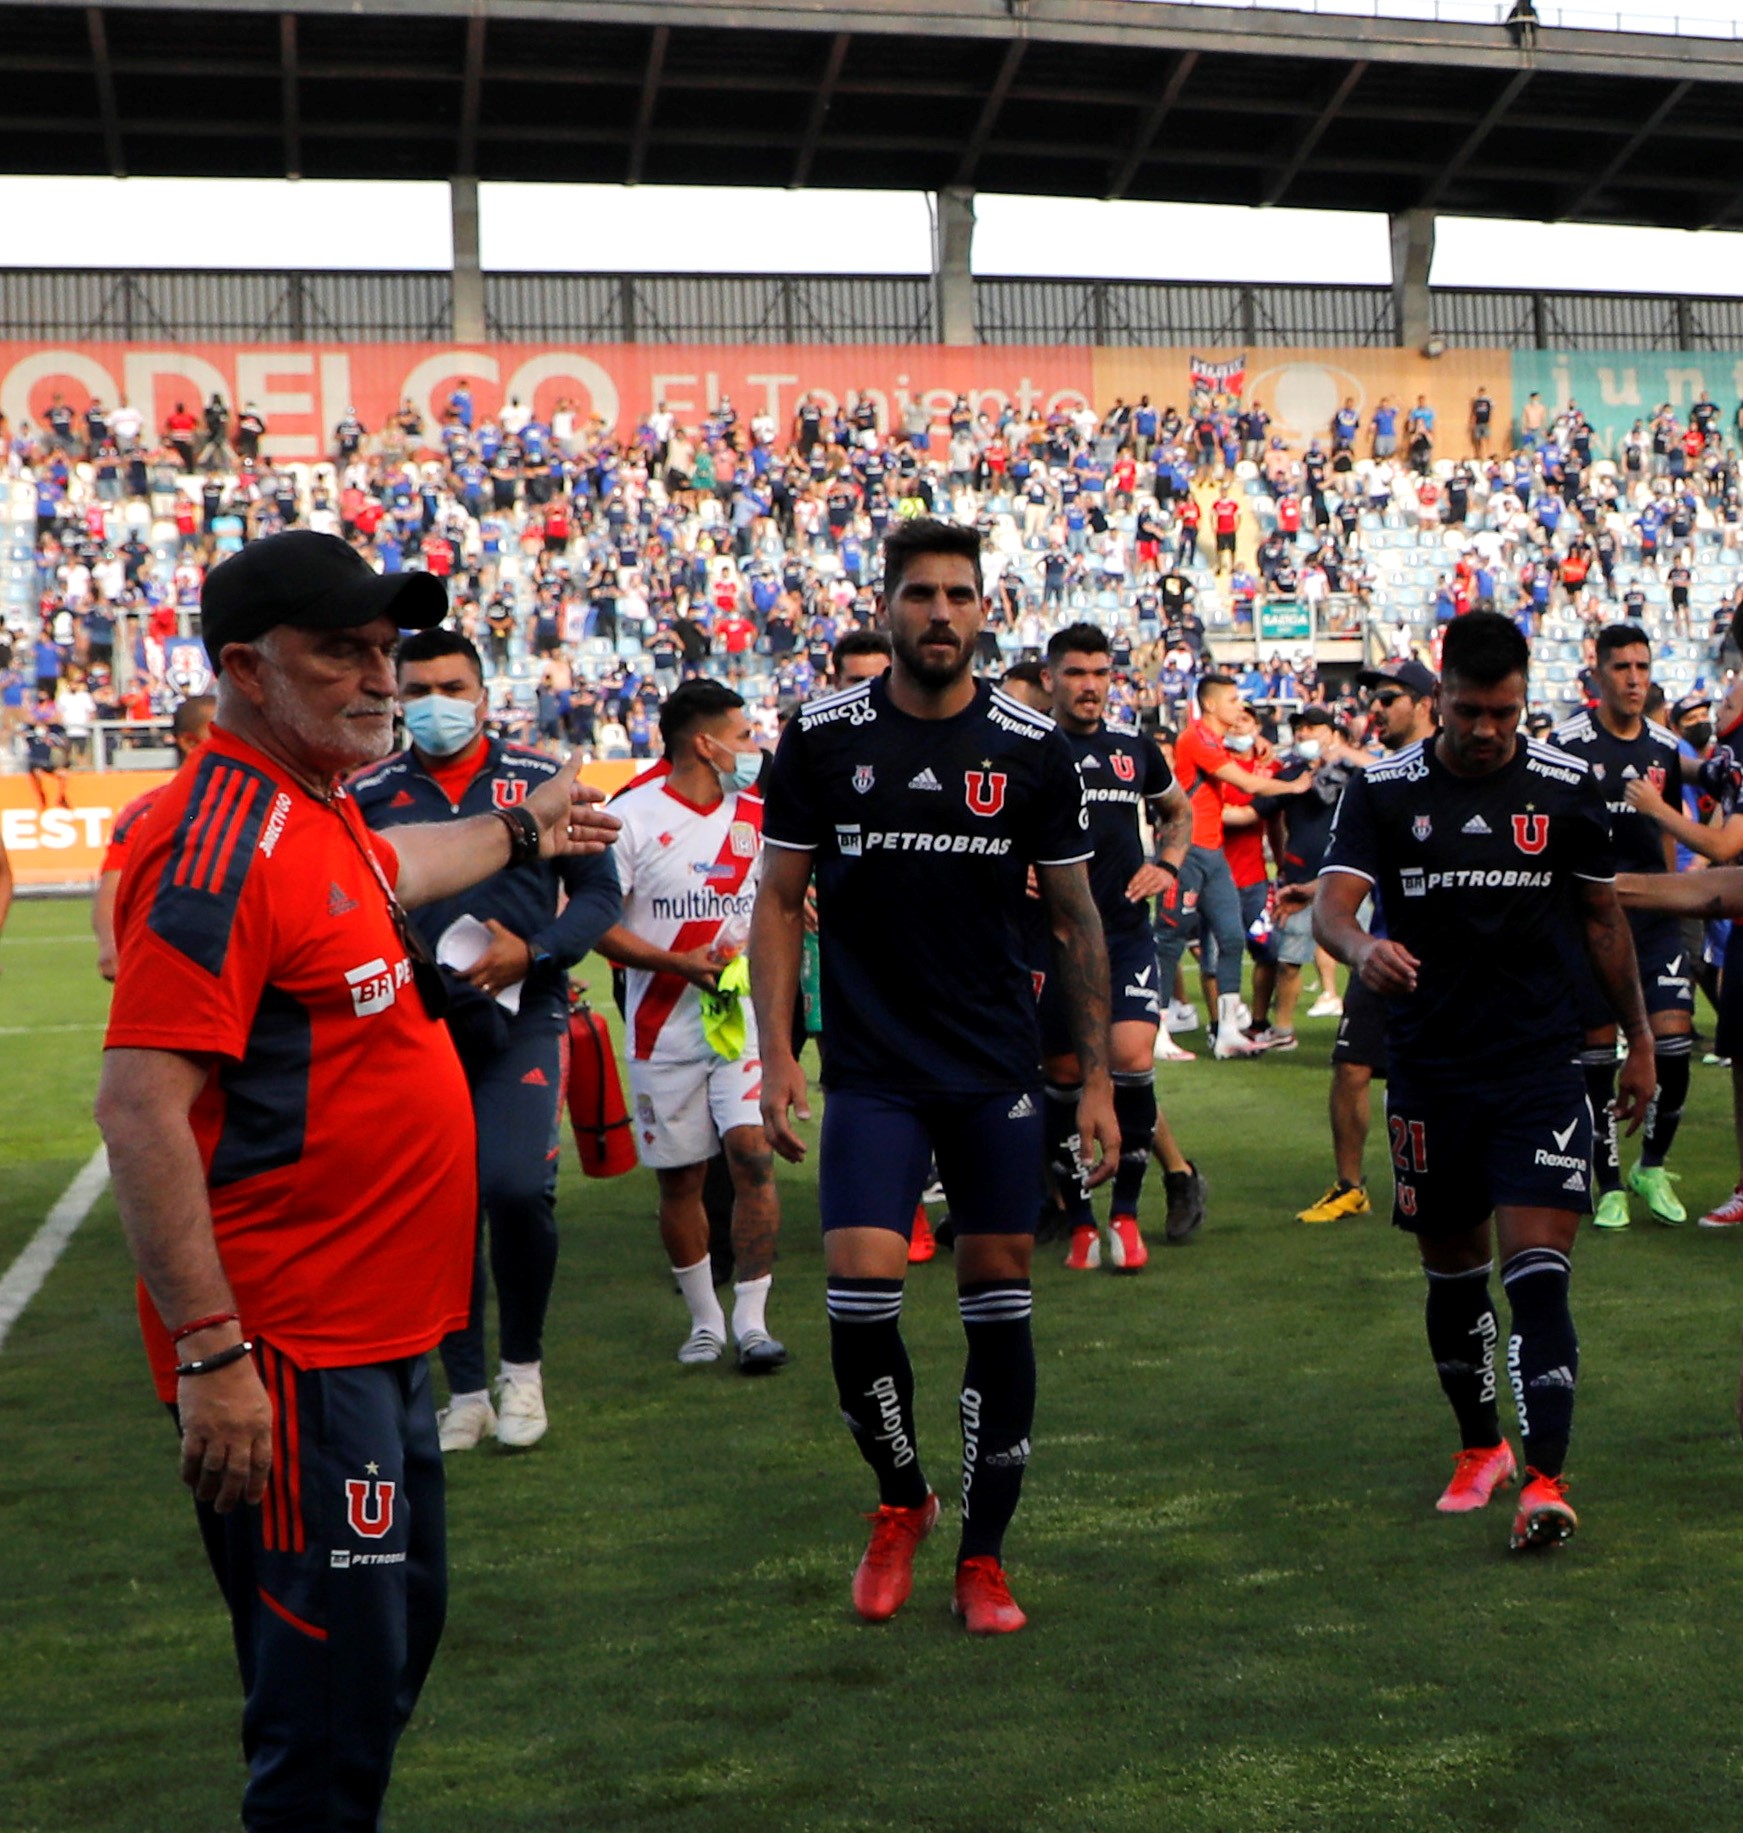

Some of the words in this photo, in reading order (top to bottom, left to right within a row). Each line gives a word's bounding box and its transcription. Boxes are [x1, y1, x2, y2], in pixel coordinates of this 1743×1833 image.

[798, 696, 870, 732] DIRECTV
[849, 708, 877, 726] GO
[987, 705, 1046, 740] Impeke
[1407, 765, 1430, 782] GO
[1526, 758, 1581, 785] Impeke
[492, 779, 528, 809] U
[964, 770, 1008, 818] U
[2, 807, 112, 851] EST
[866, 832, 1013, 855] PETROBRAS
[1511, 814, 1550, 855] U
[1428, 870, 1553, 888] PETROBRAS
[1389, 1114, 1428, 1173] 21
[1535, 1149, 1587, 1171] Rexona
[864, 1375, 915, 1469] Dolorub
[345, 1479, 395, 1538] U
